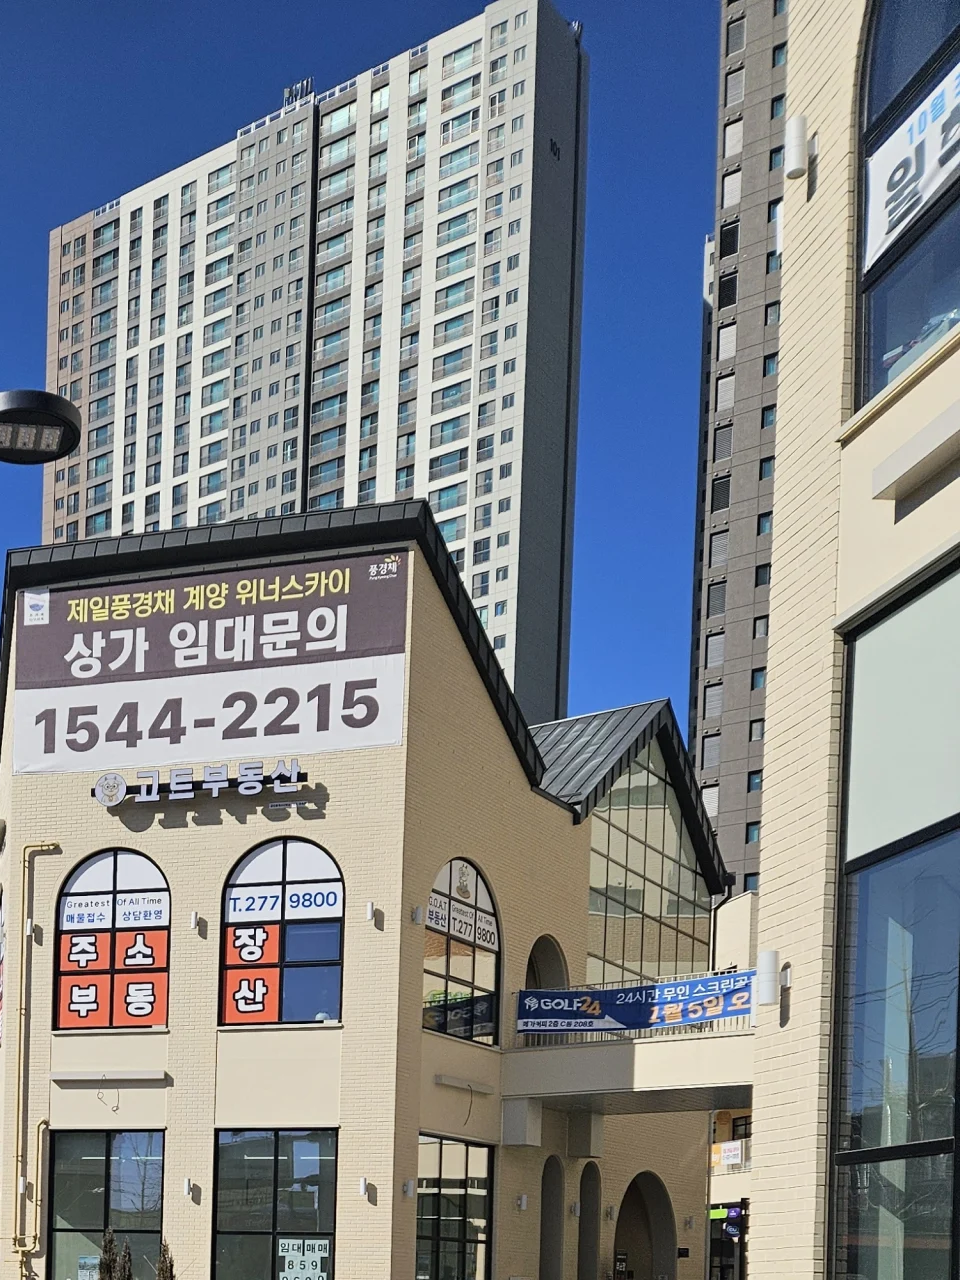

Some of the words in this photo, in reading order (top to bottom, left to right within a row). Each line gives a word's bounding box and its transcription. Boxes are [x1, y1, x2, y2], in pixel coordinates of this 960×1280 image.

[368, 562, 398, 576] 풍경채
[66, 588, 175, 624] 제일풍경채
[182, 581, 230, 612] 계양
[235, 567, 351, 607] 위너스카이
[63, 627, 150, 678] 상가
[168, 603, 349, 669] 임대문의
[34, 677, 380, 755] 1544-2215
[134, 758, 302, 803] 고트부동산
[66, 900, 110, 908] Greatest
[116, 898, 126, 906] Of
[129, 898, 140, 906] All
[142, 897, 162, 905] Time
[229, 895, 280, 913] T.277
[289, 891, 338, 909] 9800
[452, 904, 469, 918] Greatest
[66, 912, 106, 924] 매물접수
[122, 909, 163, 922] 상담환영
[428, 909, 447, 928] 부동산
[452, 917, 473, 937] T.277
[477, 926, 496, 945] 9800
[616, 990, 660, 1004] 24시간
[662, 985, 690, 1001] 무인
[648, 1002, 683, 1024] 1월
[687, 995, 725, 1019] 5일
[280, 1243, 302, 1253] 임대
[306, 1243, 328, 1254] 매매
[287, 1260, 318, 1271] 859
